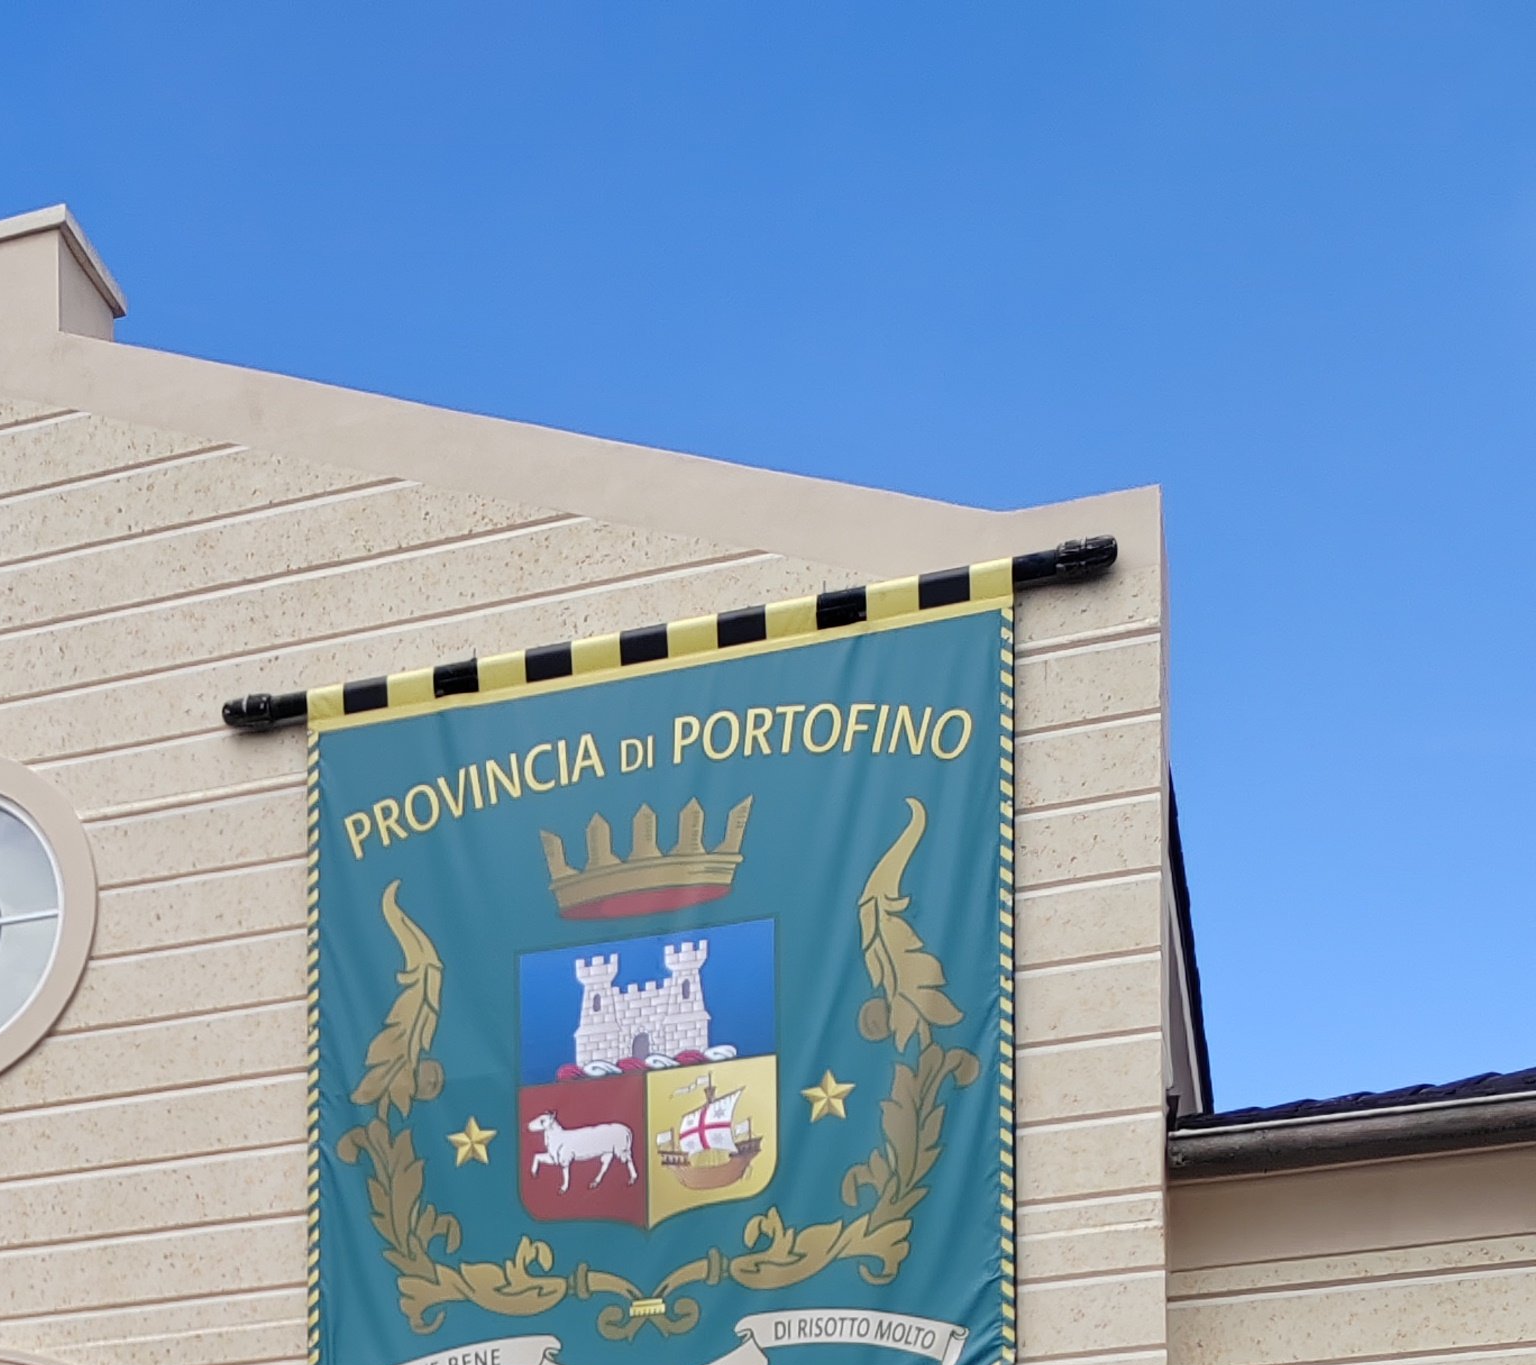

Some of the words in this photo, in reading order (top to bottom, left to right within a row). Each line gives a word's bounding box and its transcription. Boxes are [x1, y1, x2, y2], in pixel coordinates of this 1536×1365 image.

[344, 734, 606, 860] PROVINCIA
[620, 736, 654, 772] DI
[673, 703, 973, 764] PORTOFINO
[774, 1317, 795, 1343] DI
[797, 1316, 870, 1340] RISOTTO
[875, 1319, 936, 1350] MOLTO
